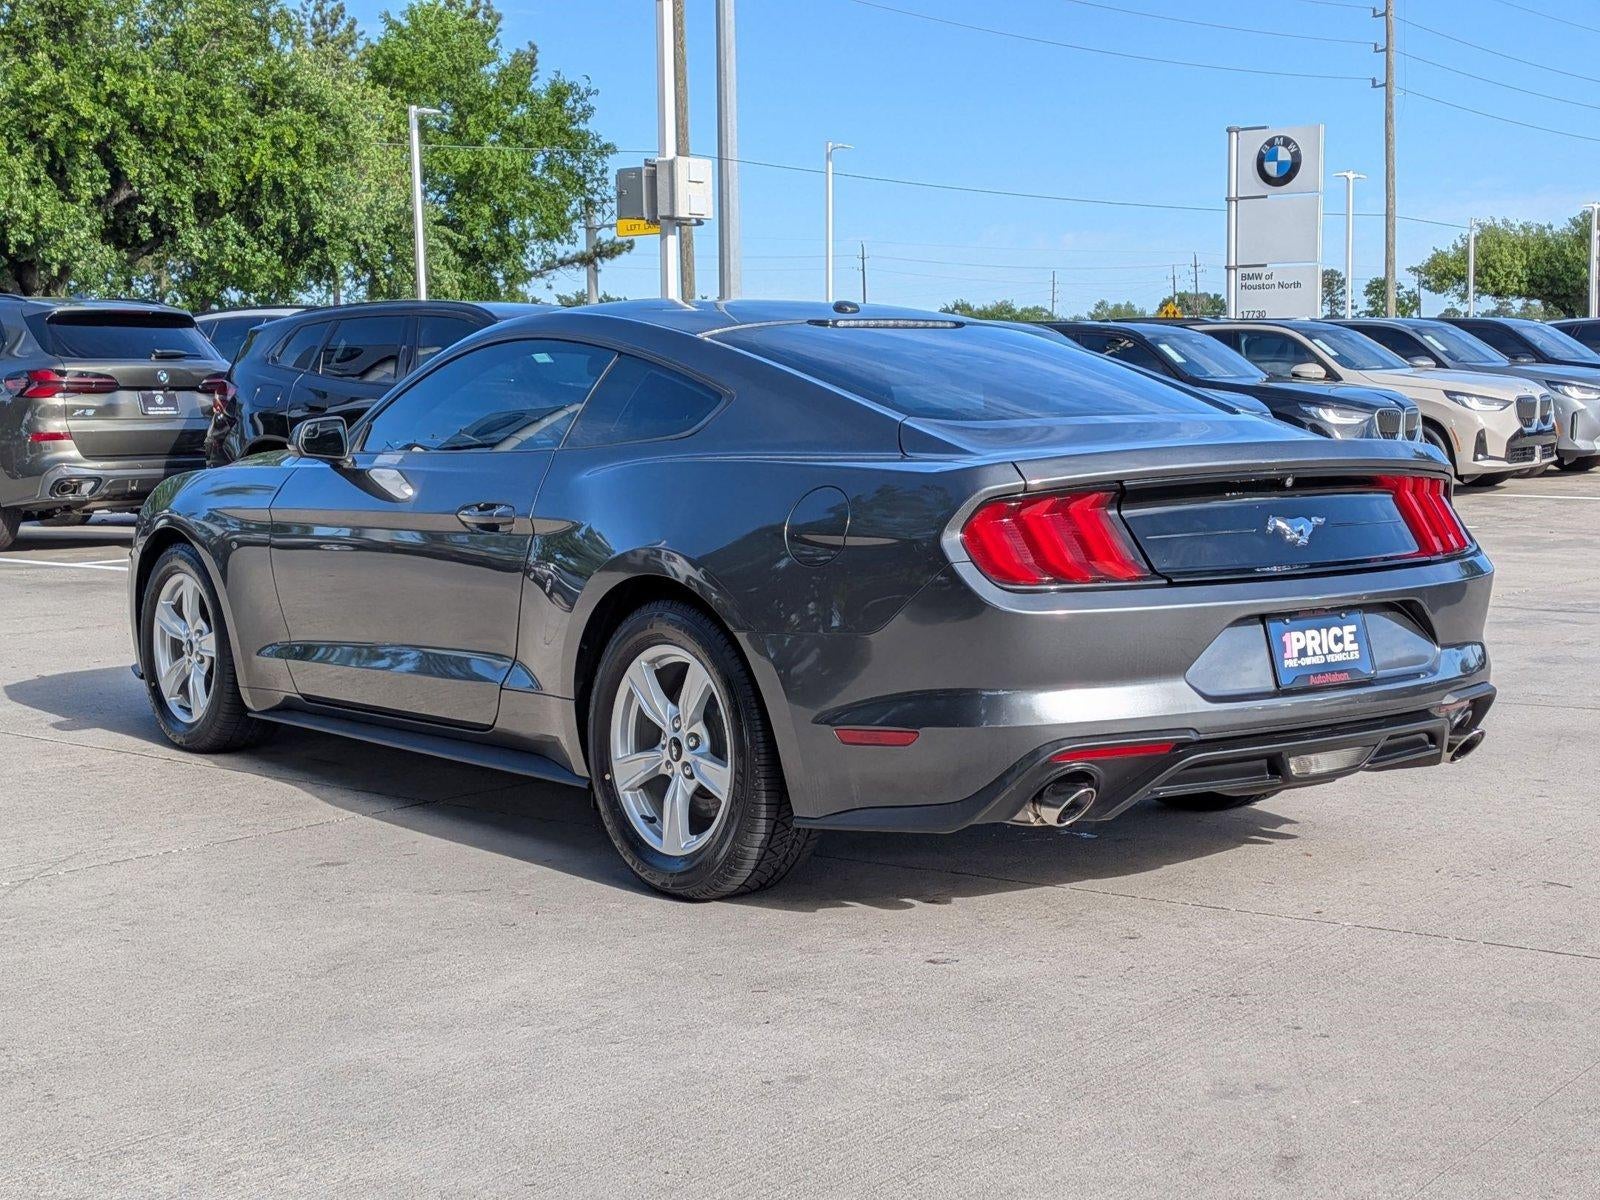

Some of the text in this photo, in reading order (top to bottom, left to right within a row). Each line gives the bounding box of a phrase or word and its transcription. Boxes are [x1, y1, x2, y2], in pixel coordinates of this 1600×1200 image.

[1261, 136, 1298, 154] BMW
[626, 223, 641, 231] LEFT
[1240, 271, 1274, 281] BMW of
[1240, 280, 1302, 290] Houston North
[1240, 310, 1267, 319] 17730
[1284, 650, 1360, 668] PRE-OWNED VEHICLES
